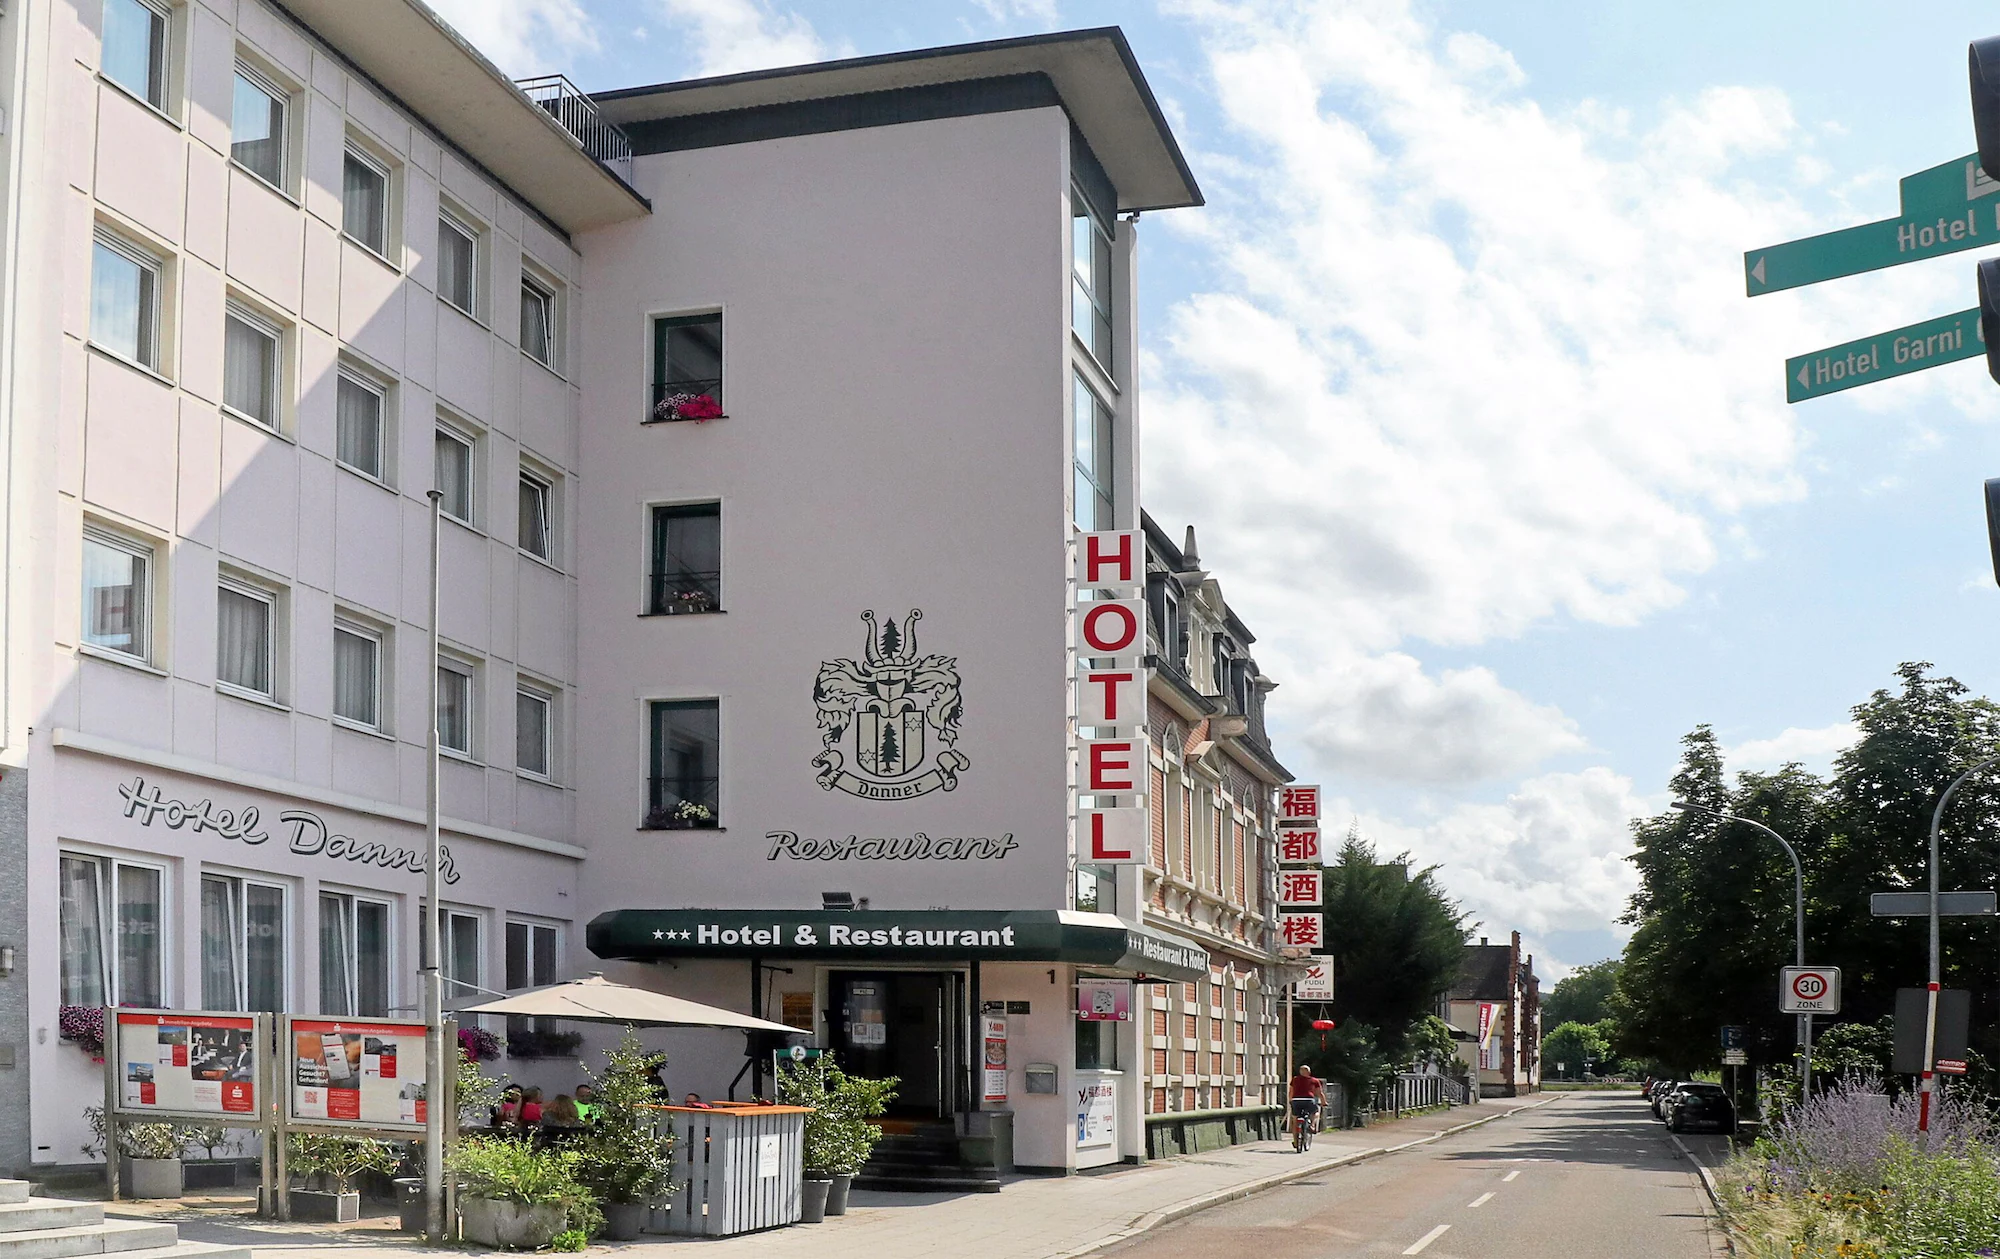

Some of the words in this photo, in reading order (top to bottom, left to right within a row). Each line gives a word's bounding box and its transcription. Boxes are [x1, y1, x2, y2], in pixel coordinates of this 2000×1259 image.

[1897, 209, 1977, 252] Hotel
[1815, 345, 1879, 385] Hotel
[1893, 321, 1962, 364] Garni
[1084, 535, 1137, 859] HOTEL
[858, 781, 922, 798] Danner
[118, 776, 268, 845] Hotel
[765, 830, 1019, 861] Restaurant
[1282, 788, 1319, 946] 福都酒楼
[697, 924, 781, 945] Hotel
[794, 924, 818, 946] &
[829, 925, 1015, 946] Restaurant
[1143, 936, 1182, 967] Restaurant
[1182, 948, 1188, 968] &
[1189, 950, 1206, 971] Hotel
[1047, 969, 1055, 985] 1
[1800, 980, 1820, 993] 30
[1797, 1001, 1823, 1009] ZONE
[298, 1069, 326, 1077] Gesucht?
[1936, 1059, 1966, 1067] atempo
[298, 1076, 329, 1084] Gefunden!
